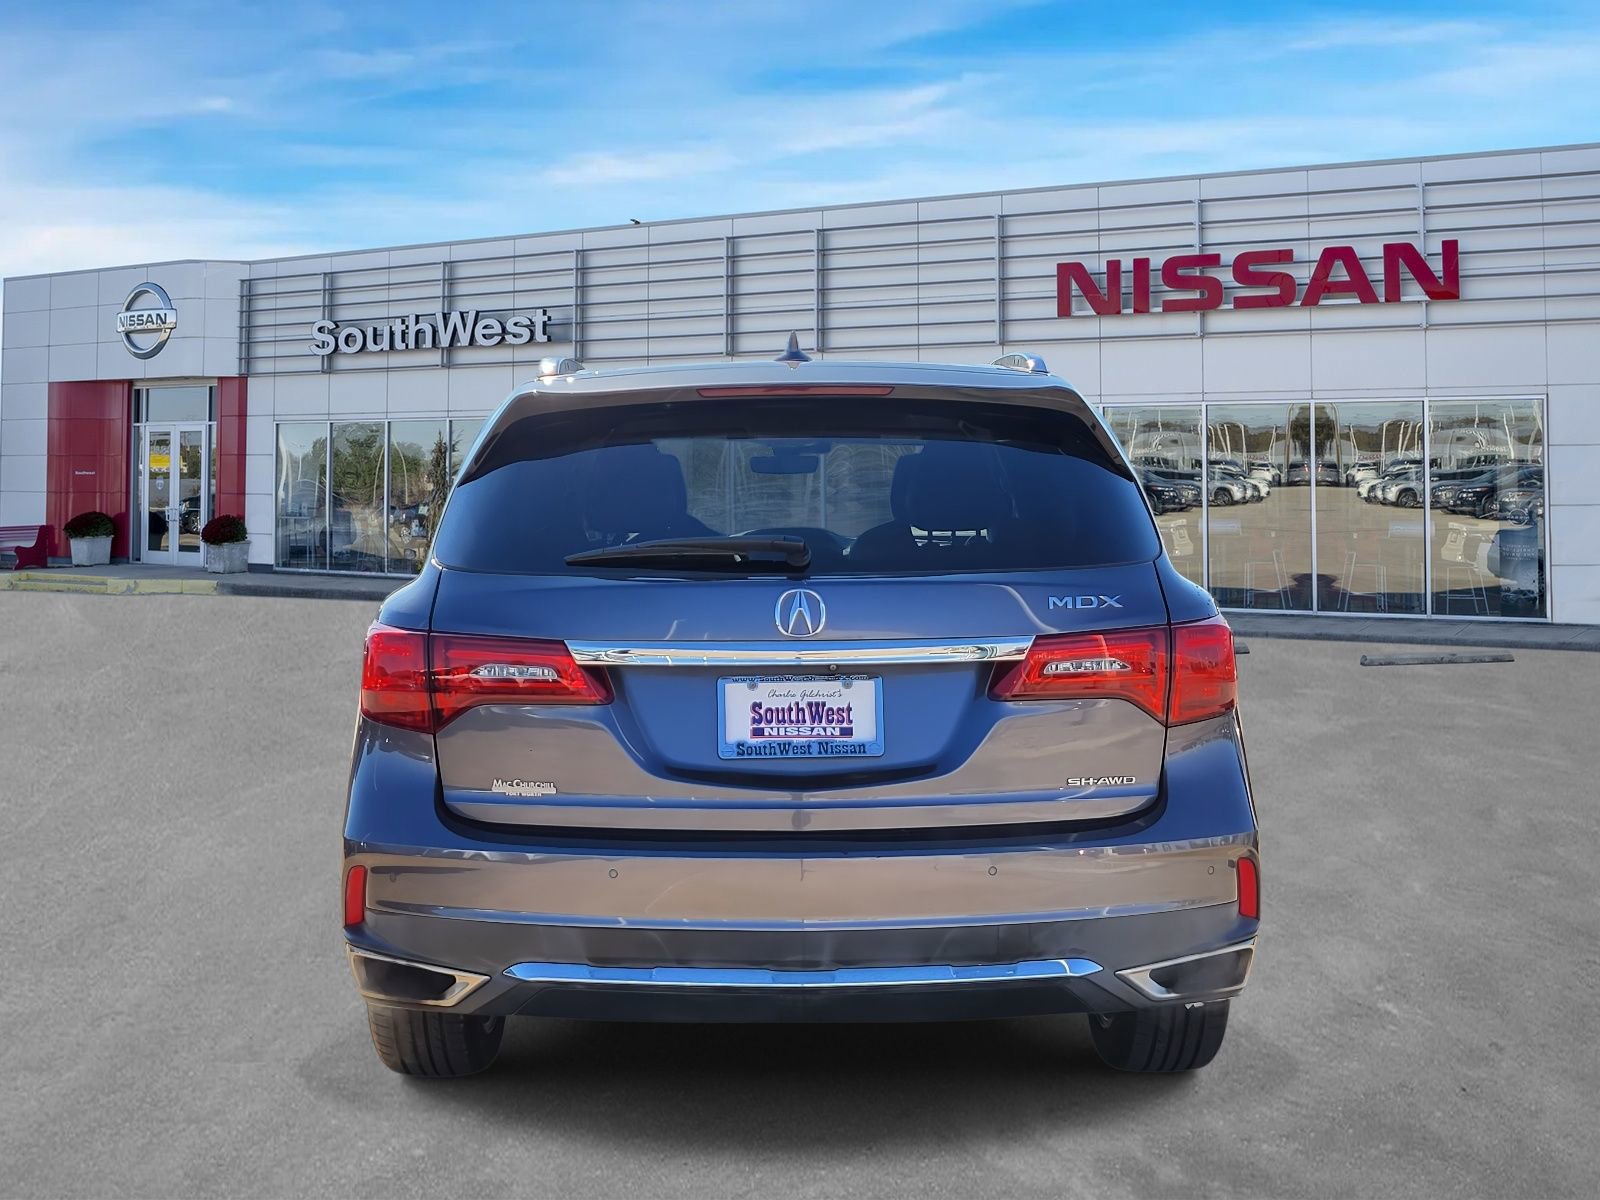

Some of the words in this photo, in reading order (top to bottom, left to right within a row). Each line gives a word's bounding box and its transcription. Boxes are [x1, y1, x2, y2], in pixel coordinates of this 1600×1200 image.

[1057, 240, 1460, 317] NISSAN
[119, 313, 167, 327] NISSAN
[309, 308, 551, 356] SouthWest
[1048, 595, 1123, 609] MDX
[751, 700, 853, 726] SouthWest
[764, 727, 840, 736] NISSAN
[736, 742, 812, 756] SouthWest
[818, 742, 867, 755] Nissan
[1067, 776, 1136, 786] SH-AWD
